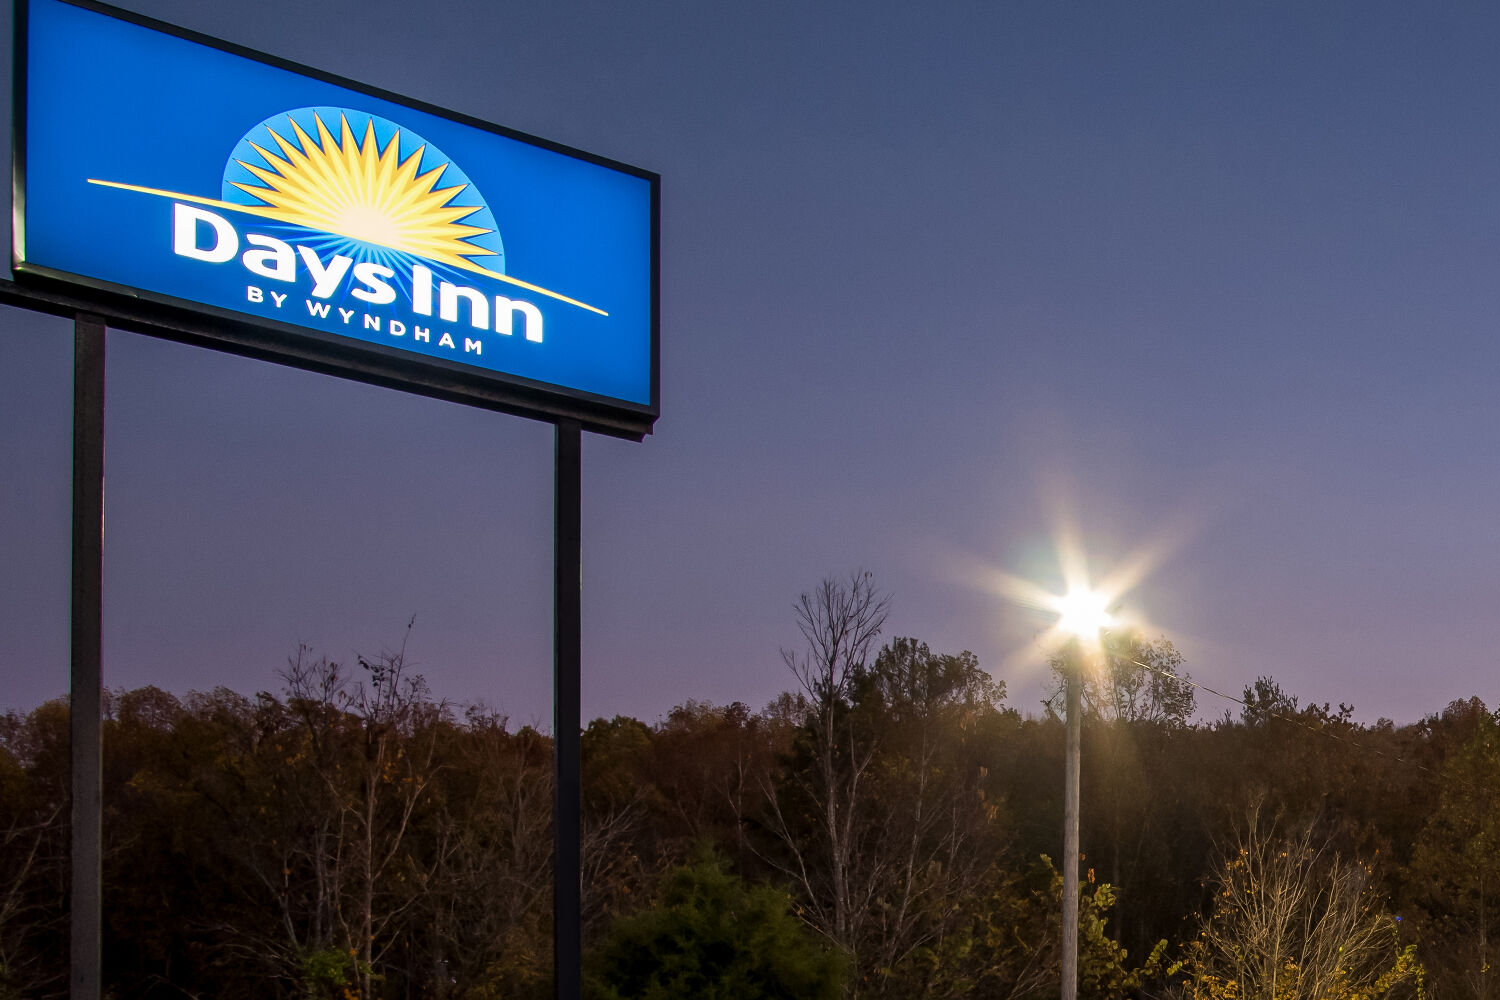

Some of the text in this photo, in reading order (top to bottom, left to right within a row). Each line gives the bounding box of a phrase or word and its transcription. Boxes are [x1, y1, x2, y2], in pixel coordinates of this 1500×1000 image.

[174, 202, 544, 343] Days Inn
[247, 285, 482, 355] BY WYNDHAM
